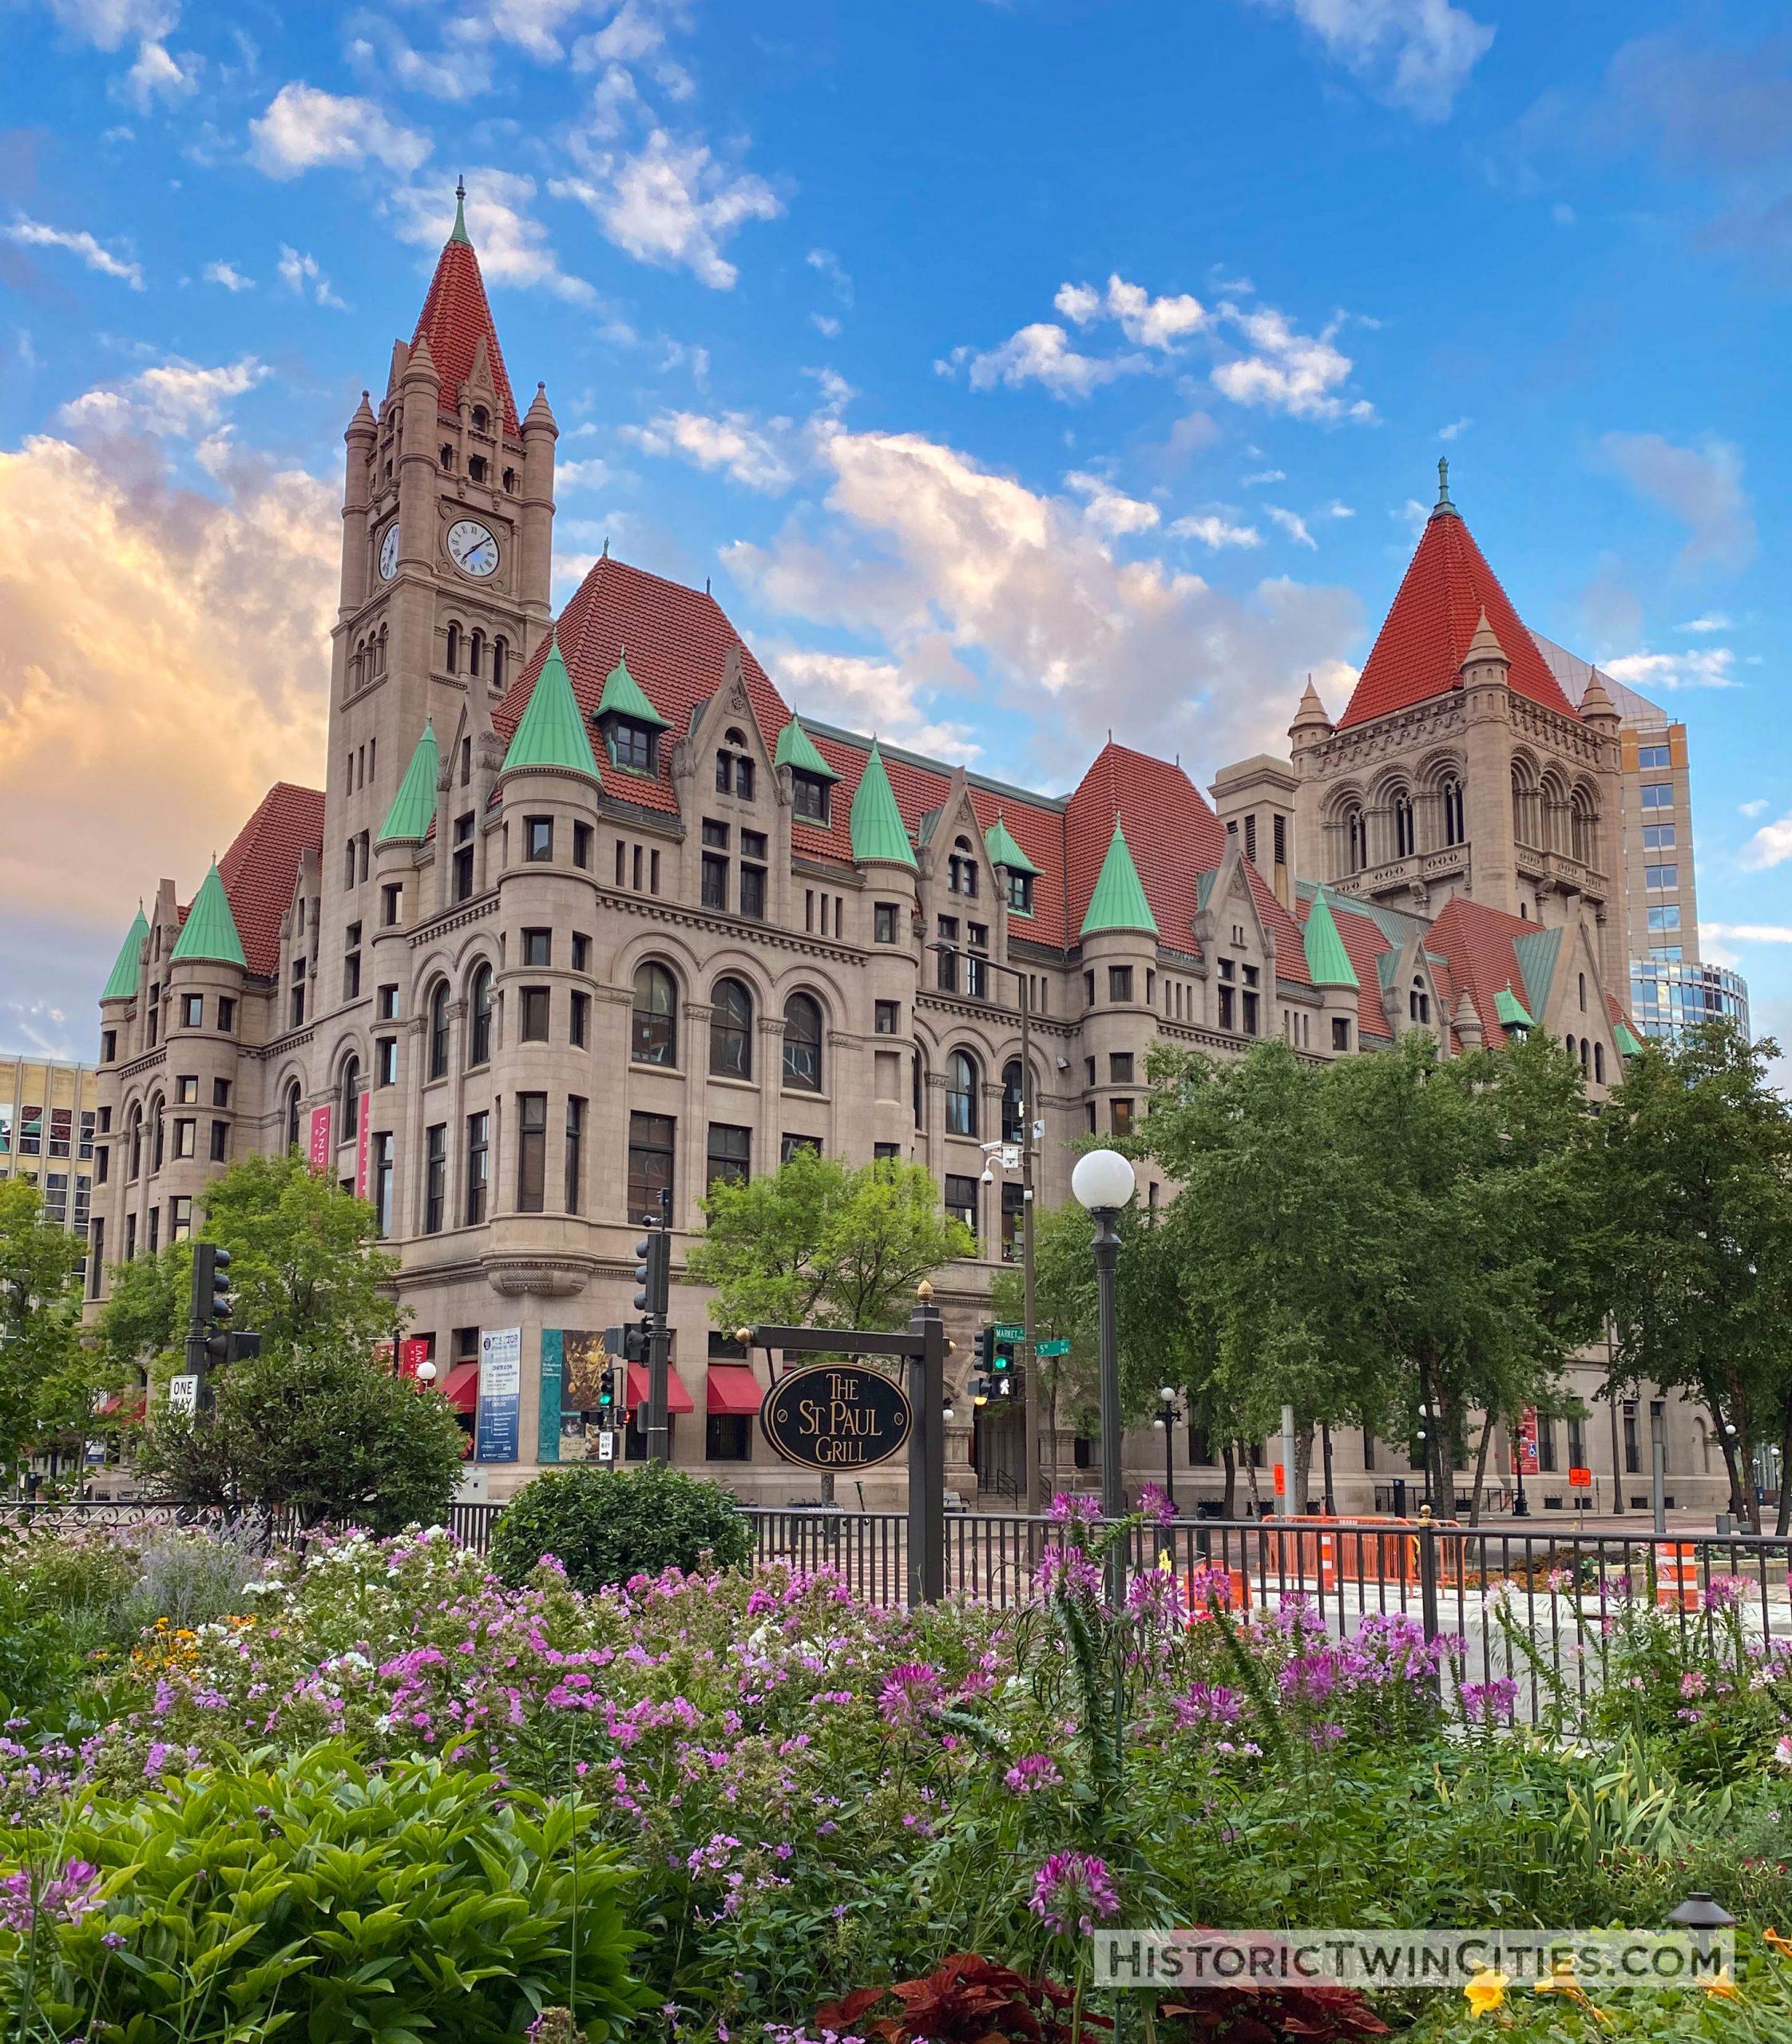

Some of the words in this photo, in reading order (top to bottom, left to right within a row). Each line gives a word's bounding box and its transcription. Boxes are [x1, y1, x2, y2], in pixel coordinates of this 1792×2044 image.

[318, 1116, 327, 1163] LAND
[996, 1329, 1017, 1339] MARKET
[173, 1381, 192, 1395] ONE
[826, 1373, 858, 1400] THE
[172, 1398, 192, 1412] WAY
[799, 1400, 826, 1435] ST
[829, 1400, 882, 1436] PAUL
[815, 1436, 867, 1463] GRILL
